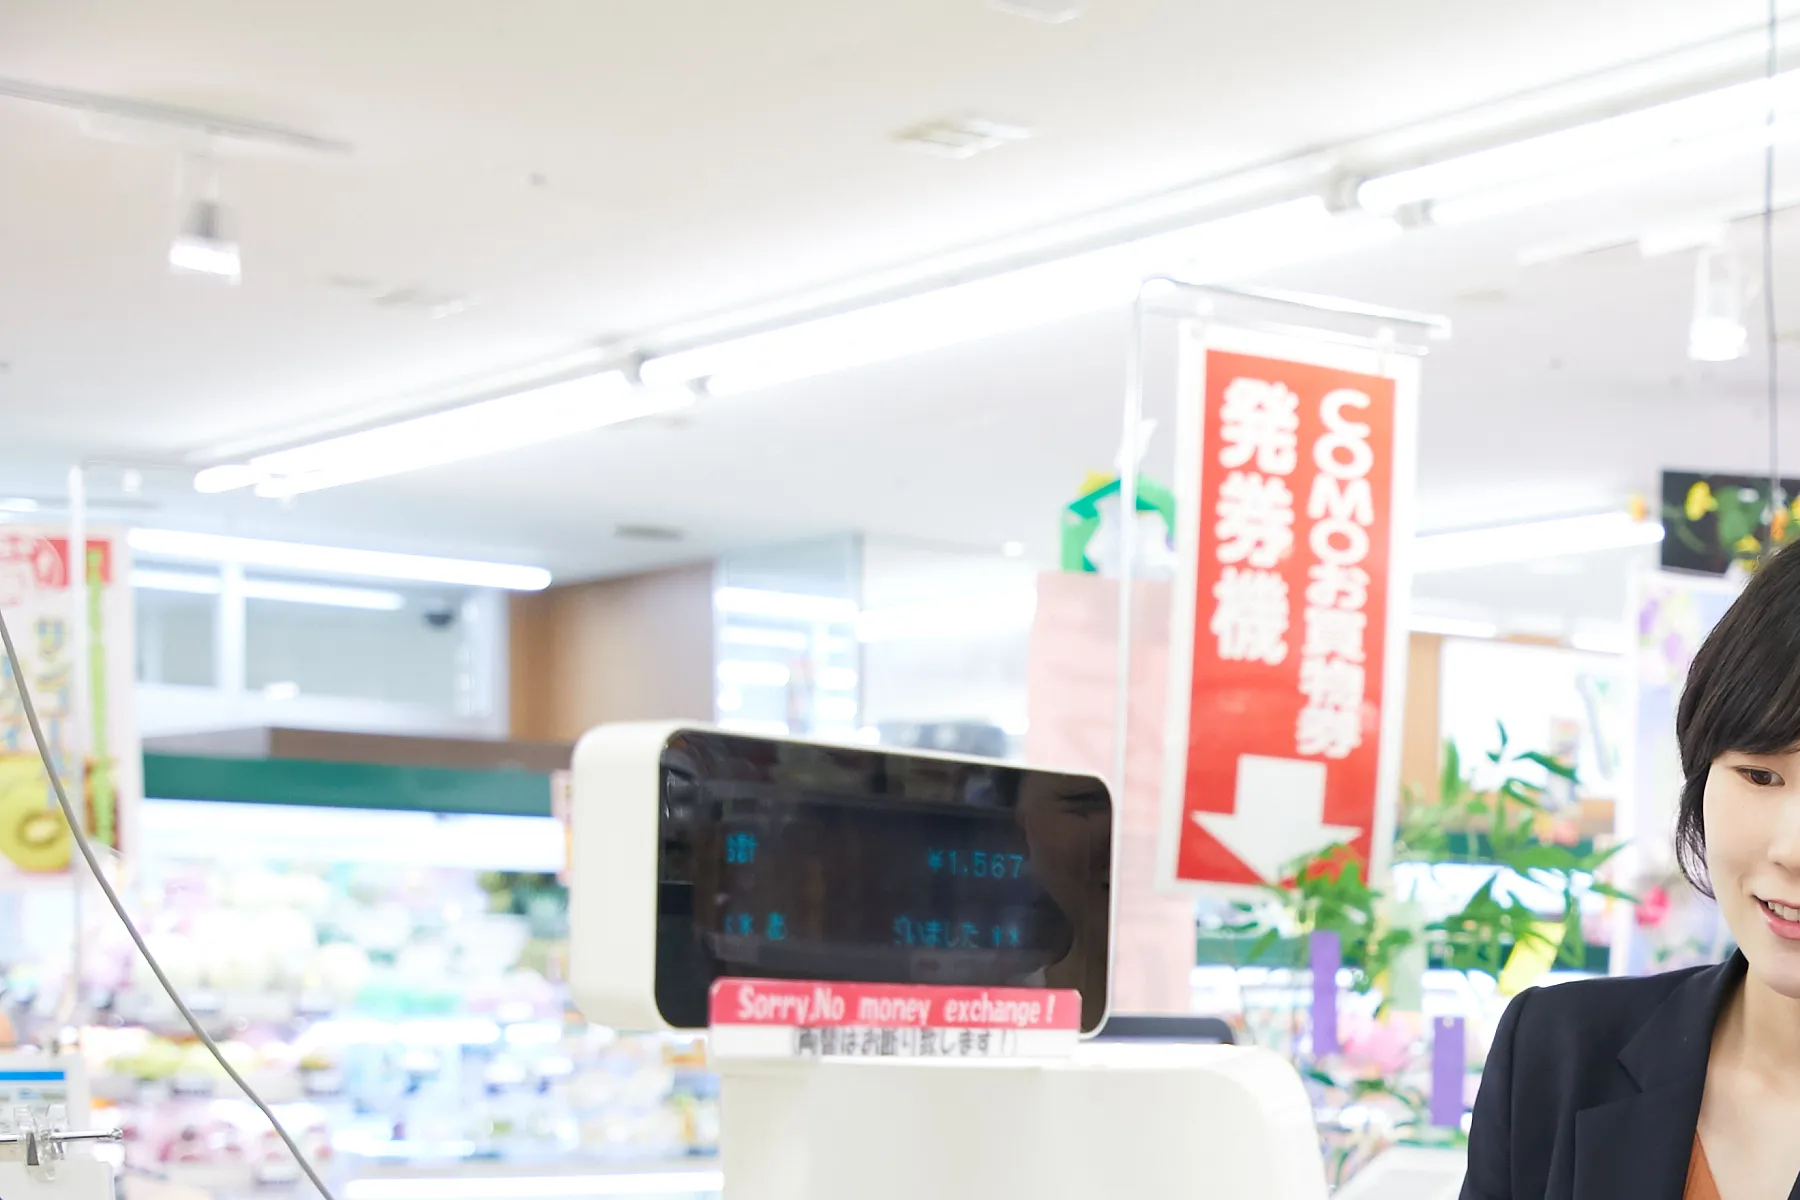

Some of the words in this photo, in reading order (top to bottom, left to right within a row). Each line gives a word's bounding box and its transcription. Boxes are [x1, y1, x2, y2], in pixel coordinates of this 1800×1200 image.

[1211, 377, 1298, 664] 発券機
[738, 985, 845, 1026] Sorry,No
[859, 997, 931, 1027] money
